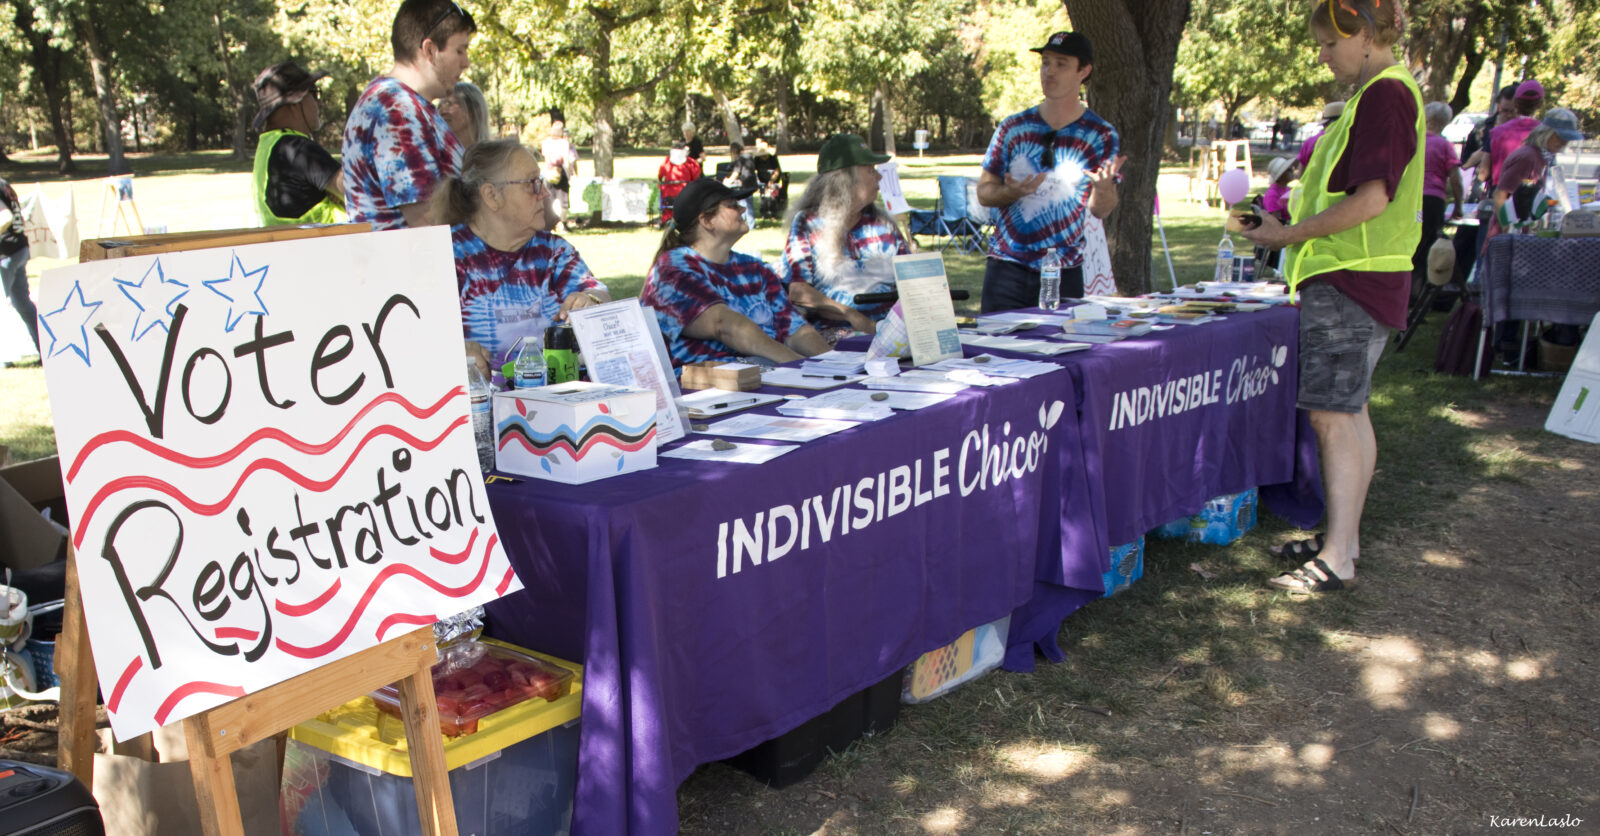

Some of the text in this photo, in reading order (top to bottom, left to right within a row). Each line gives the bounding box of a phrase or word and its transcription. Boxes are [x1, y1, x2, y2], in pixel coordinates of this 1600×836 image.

[94, 293, 421, 439] Voter
[1108, 355, 1272, 431] INDIVISIBLE Chico
[101, 446, 487, 670] Registration
[716, 421, 1045, 579] INDIVISIBLE Chico
